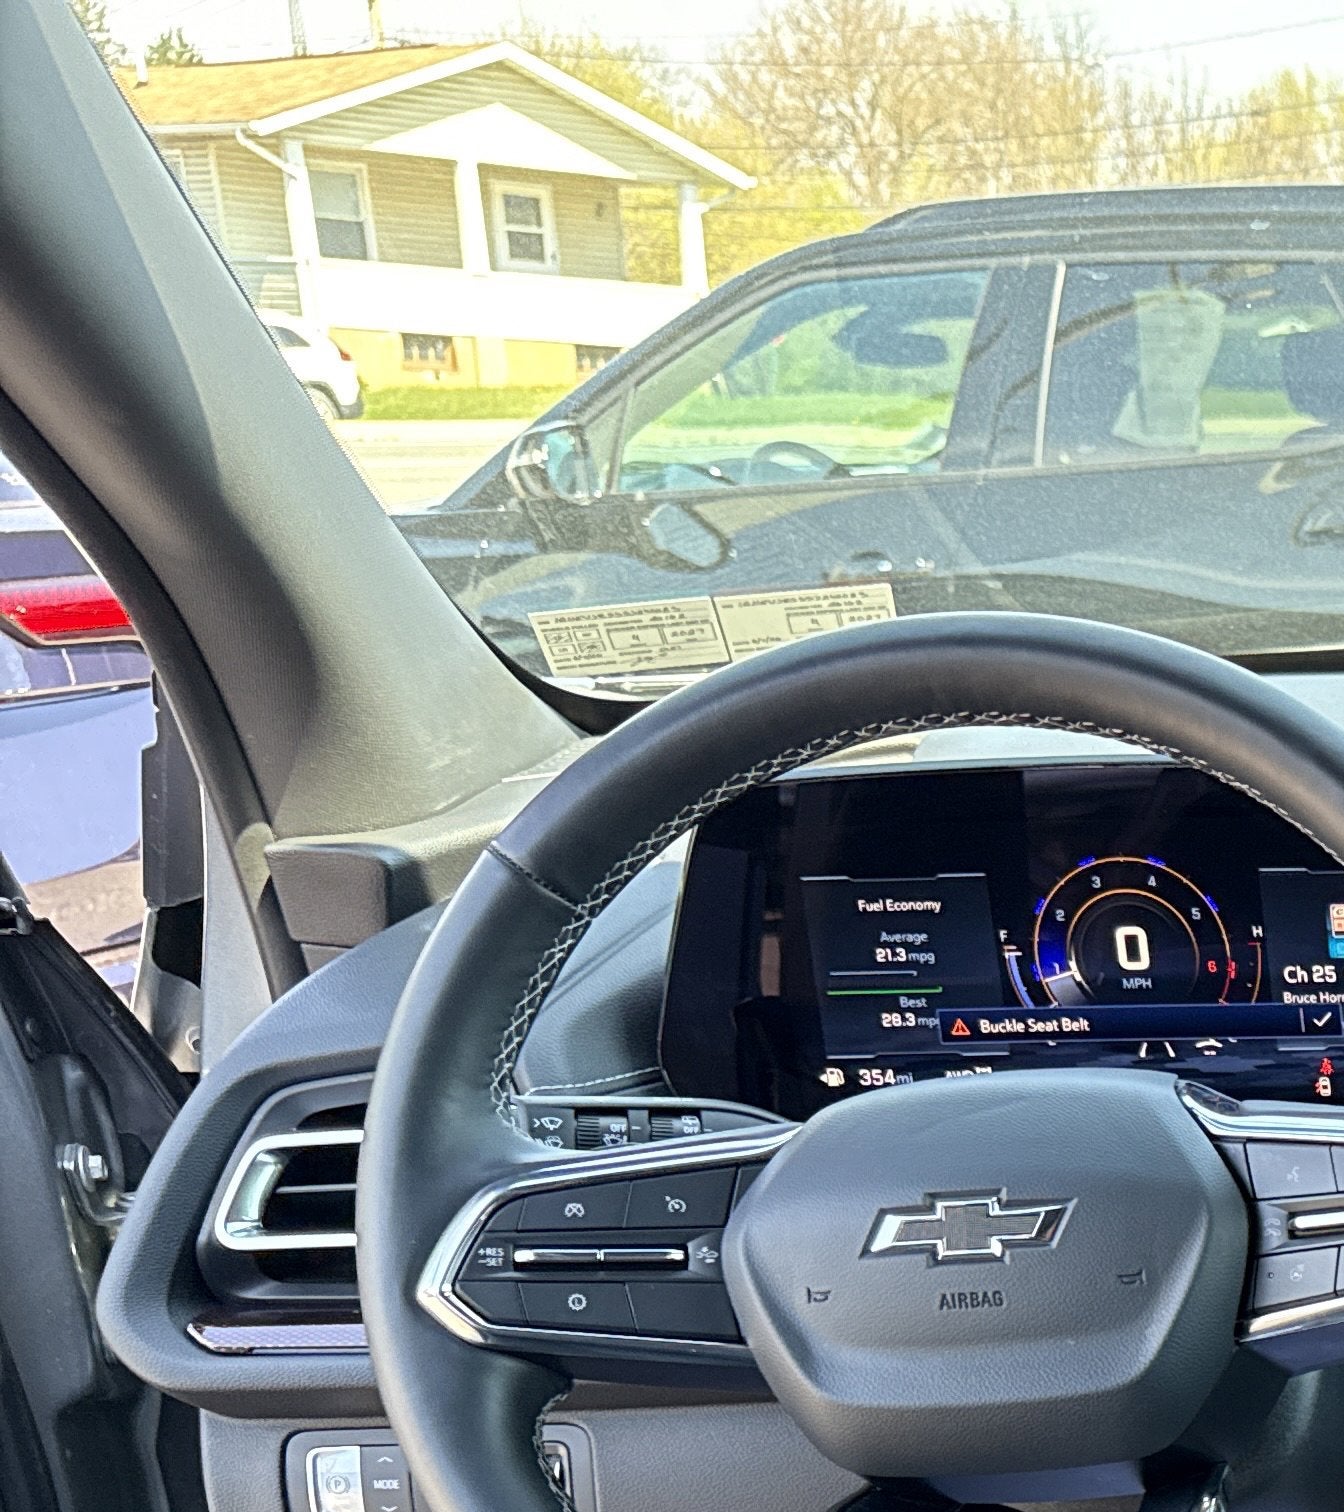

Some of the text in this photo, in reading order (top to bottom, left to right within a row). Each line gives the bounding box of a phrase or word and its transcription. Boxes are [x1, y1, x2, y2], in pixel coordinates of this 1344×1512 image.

[1091, 875, 1102, 888] 3
[1147, 875, 1157, 888] 4
[857, 898, 942, 914] Fuel Economy
[1055, 909, 1066, 922] 2
[1191, 907, 1202, 921] 5
[879, 931, 928, 945] Average
[998, 930, 1008, 942] F
[1252, 926, 1264, 939] H
[1114, 925, 1151, 971] 0
[908, 951, 936, 965] mpg
[1283, 965, 1308, 983] Ch
[1312, 965, 1337, 983] 25
[1122, 977, 1153, 990] MPH
[898, 996, 928, 1008] Best
[1283, 991, 1318, 1004] Bruce
[881, 1012, 939, 1028] 28.3 mp
[980, 1017, 1090, 1034] Buckle Seat Belt
[858, 1069, 896, 1086] 354
[939, 1289, 1004, 1311] AIRBAG
[373, 1479, 400, 1490] MODE
